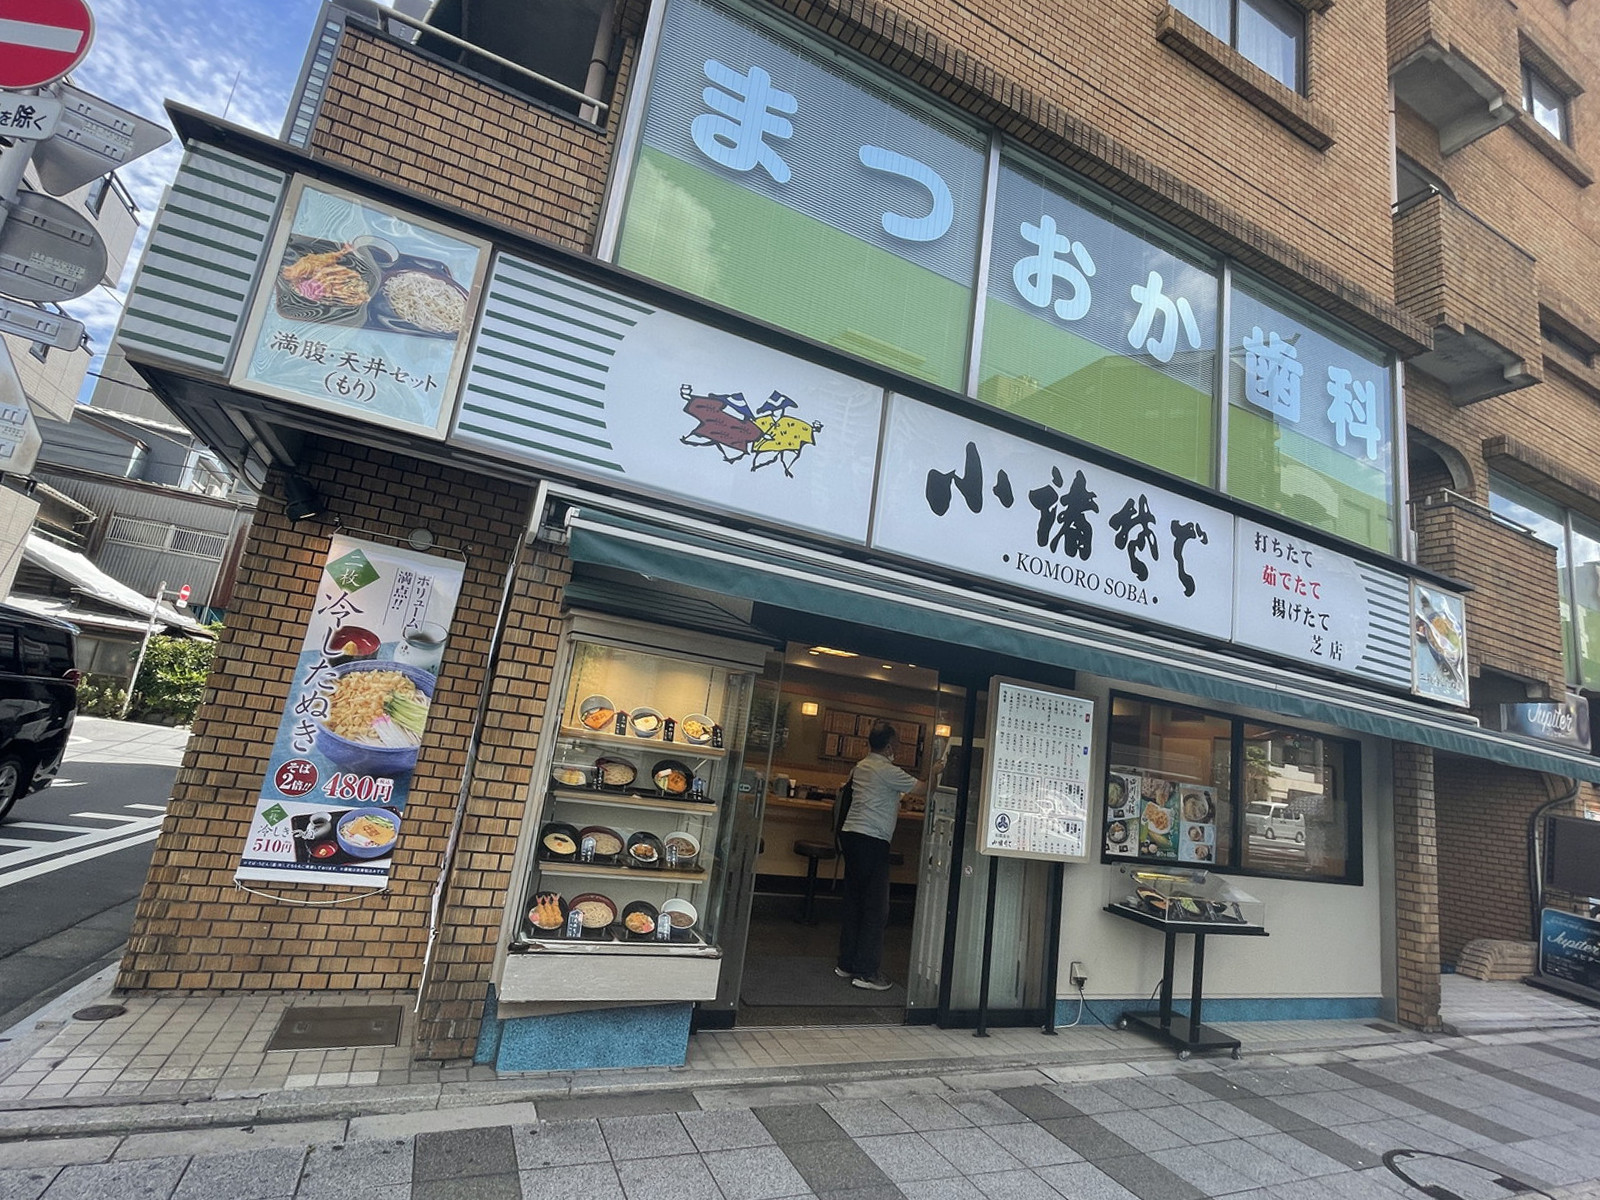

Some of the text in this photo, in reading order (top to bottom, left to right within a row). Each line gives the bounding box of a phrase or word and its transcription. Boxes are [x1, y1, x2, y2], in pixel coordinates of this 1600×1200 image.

[691, 58, 1382, 461] まつおか歯科
[324, 371, 376, 402] (もり)
[1254, 532, 1313, 568] 打ちたて
[340, 555, 364, 587] 二枚
[1015, 552, 1149, 605] KOMORO SOBA
[1262, 565, 1321, 600] 茹でたて
[1272, 597, 1330, 631] 揚げたて
[1310, 634, 1343, 661] 芝店
[294, 591, 363, 752] 冷したぬき
[1527, 703, 1573, 733] Jupiter
[321, 772, 394, 803] 480円
[252, 838, 292, 854] 510円
[1547, 931, 1600, 956] Jupiter
